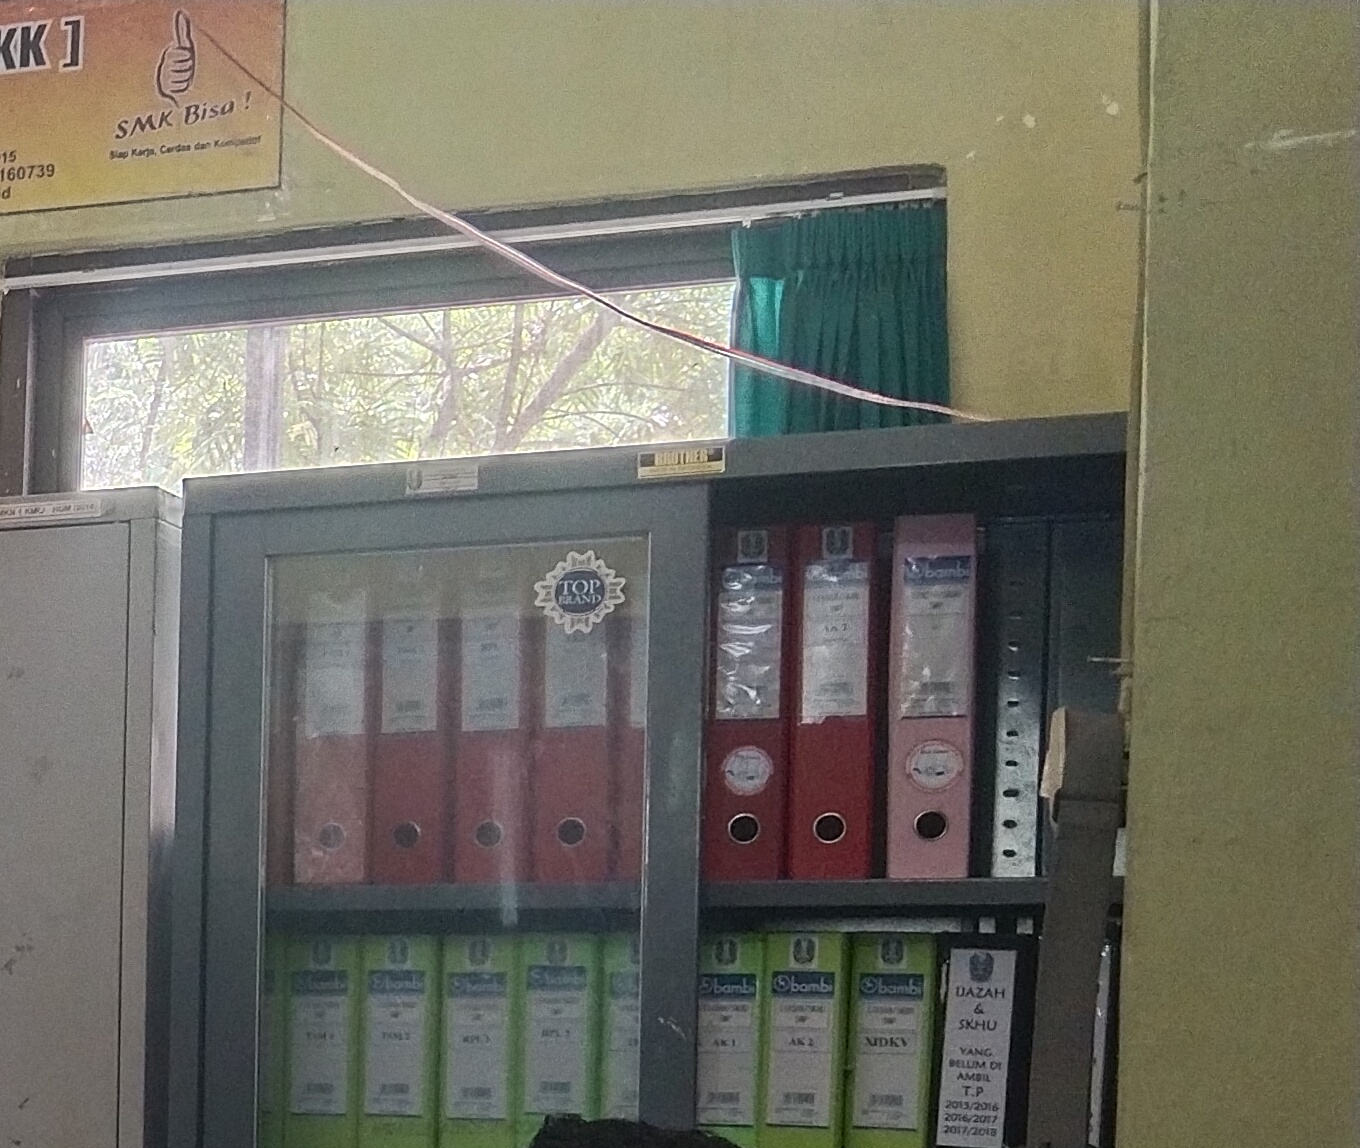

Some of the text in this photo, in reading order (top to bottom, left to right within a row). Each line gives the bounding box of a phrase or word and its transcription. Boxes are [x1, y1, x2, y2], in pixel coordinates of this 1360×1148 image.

[114, 109, 174, 140] SMK
[184, 100, 236, 126] Bisa
[558, 579, 601, 596] TOP
[558, 594, 602, 606] BRAND
[713, 977, 756, 994] bambi
[790, 975, 833, 993] bambi
[878, 976, 922, 995] bambi
[973, 1001, 985, 1015] &
[958, 1017, 998, 1032] SKHU
[959, 1046, 993, 1058] YANG
[948, 1059, 986, 1070] BELUM
[956, 1071, 991, 1083] AMBIL
